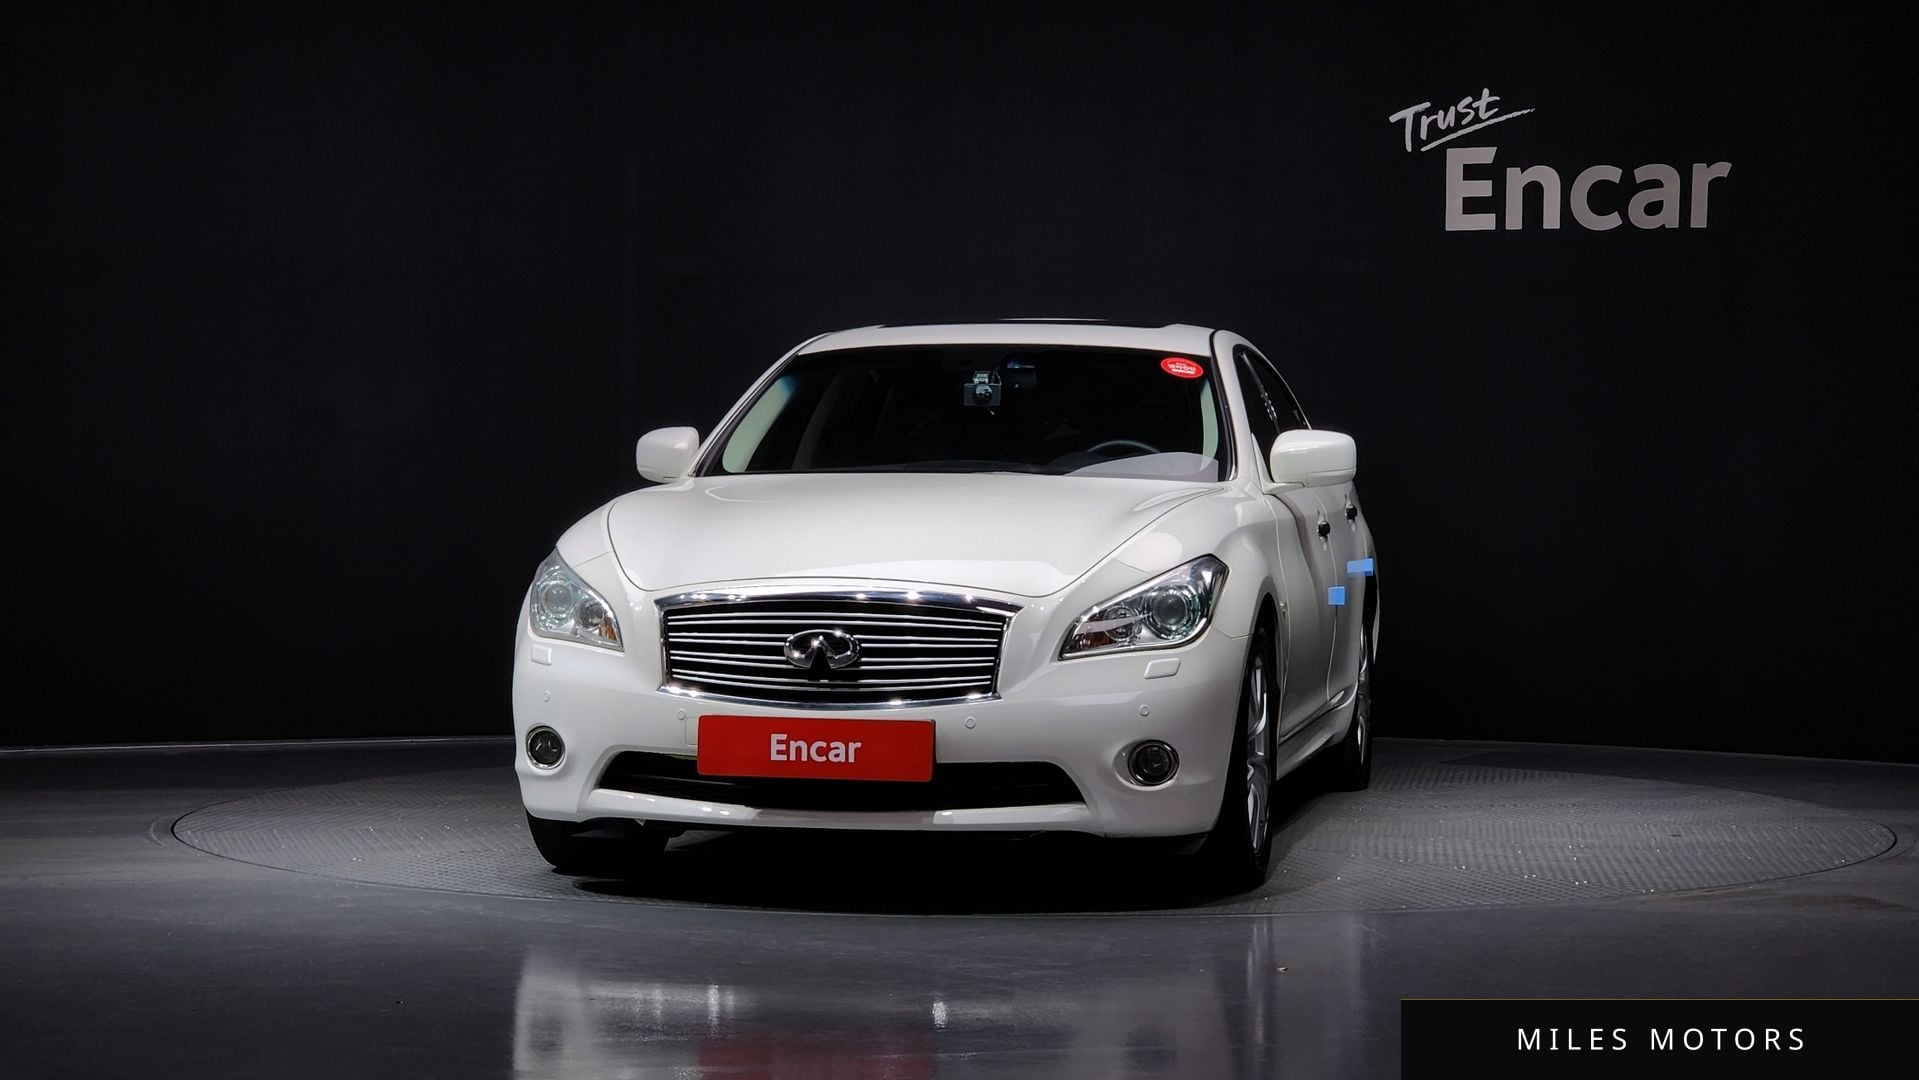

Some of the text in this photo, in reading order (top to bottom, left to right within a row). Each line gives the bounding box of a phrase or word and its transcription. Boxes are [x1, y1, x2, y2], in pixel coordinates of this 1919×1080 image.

[1388, 87, 1501, 153] Trust
[1445, 146, 1732, 231] Encar
[770, 733, 862, 763] Encar
